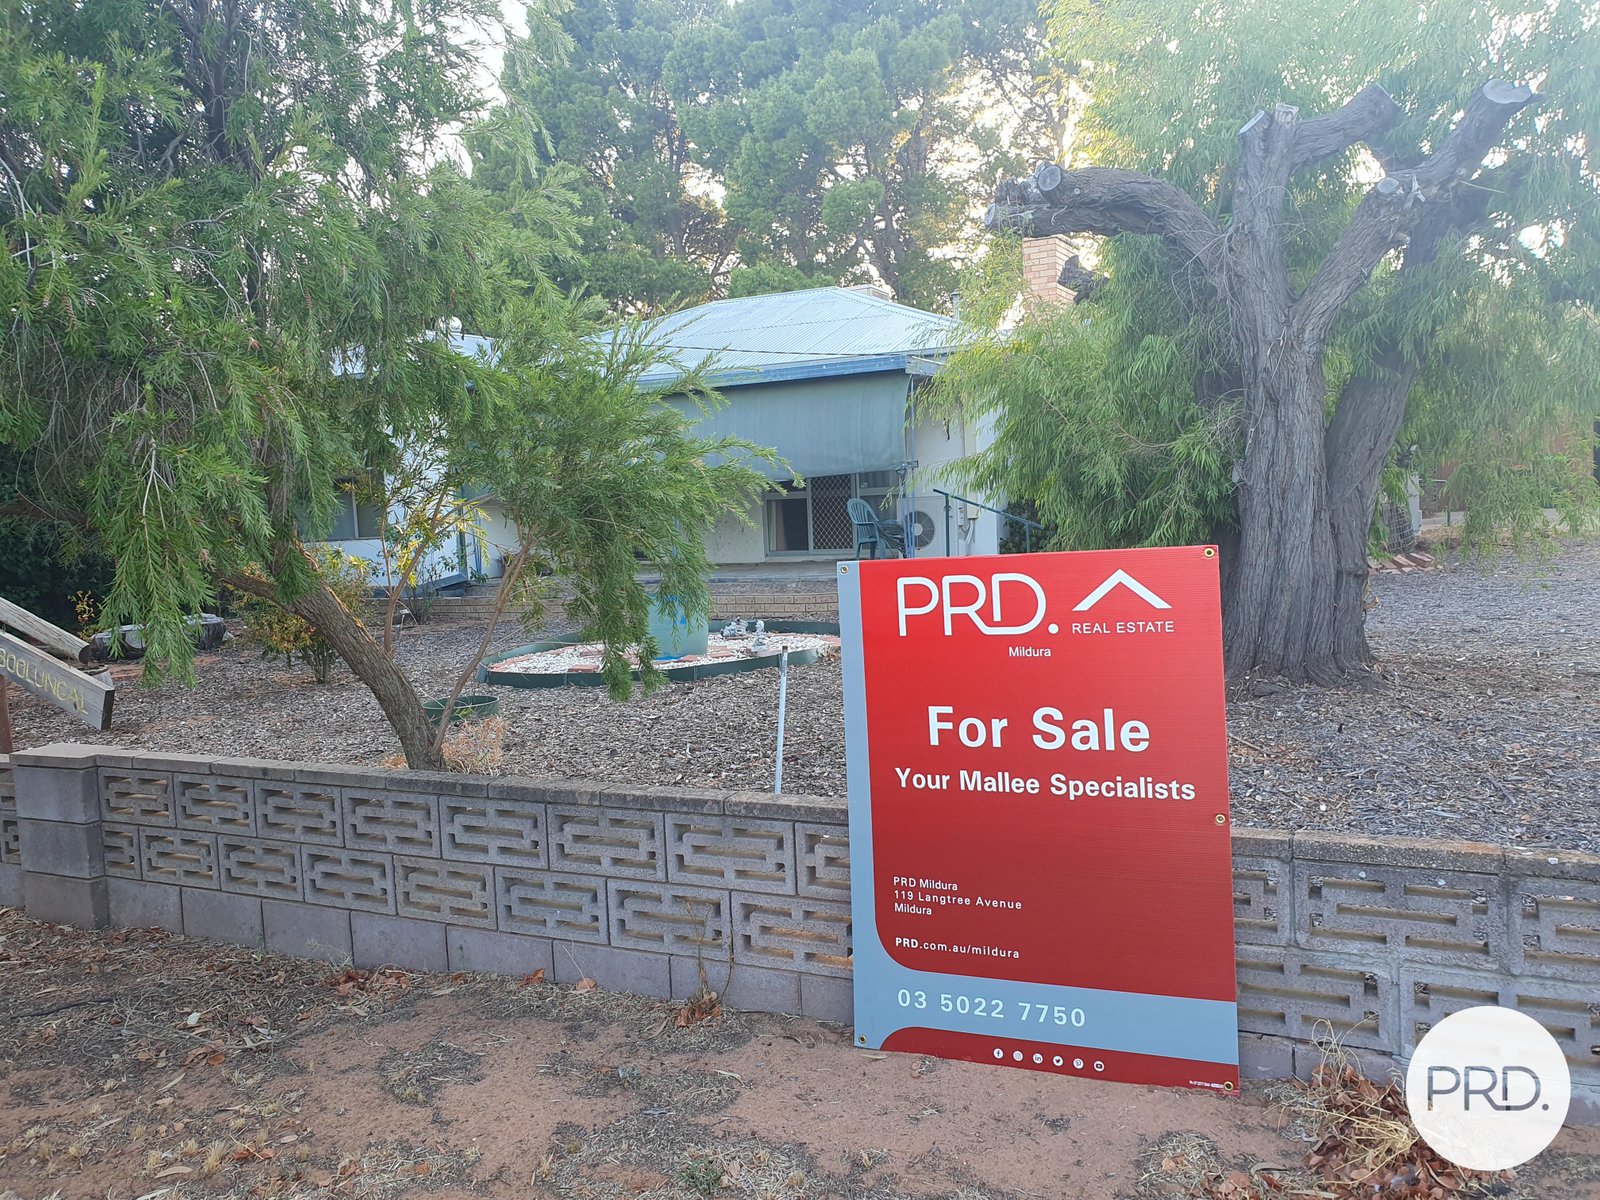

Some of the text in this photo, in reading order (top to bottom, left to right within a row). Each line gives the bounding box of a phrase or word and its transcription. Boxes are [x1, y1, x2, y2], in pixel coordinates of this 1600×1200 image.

[896, 572, 1059, 637] PRD.
[1071, 620, 1175, 635] REAL ESTATE
[1008, 646, 1052, 658] Mildura
[928, 705, 1151, 752] For Sale
[895, 768, 1196, 801] Your Mallee Specialists
[893, 876, 958, 891] PRD Mildura
[894, 890, 1023, 910] 119 Langtree Avenue
[894, 903, 932, 915] Mildura
[895, 937, 1020, 959] PRD.com.au/mildura
[897, 989, 1086, 1027] 03 5022 7750
